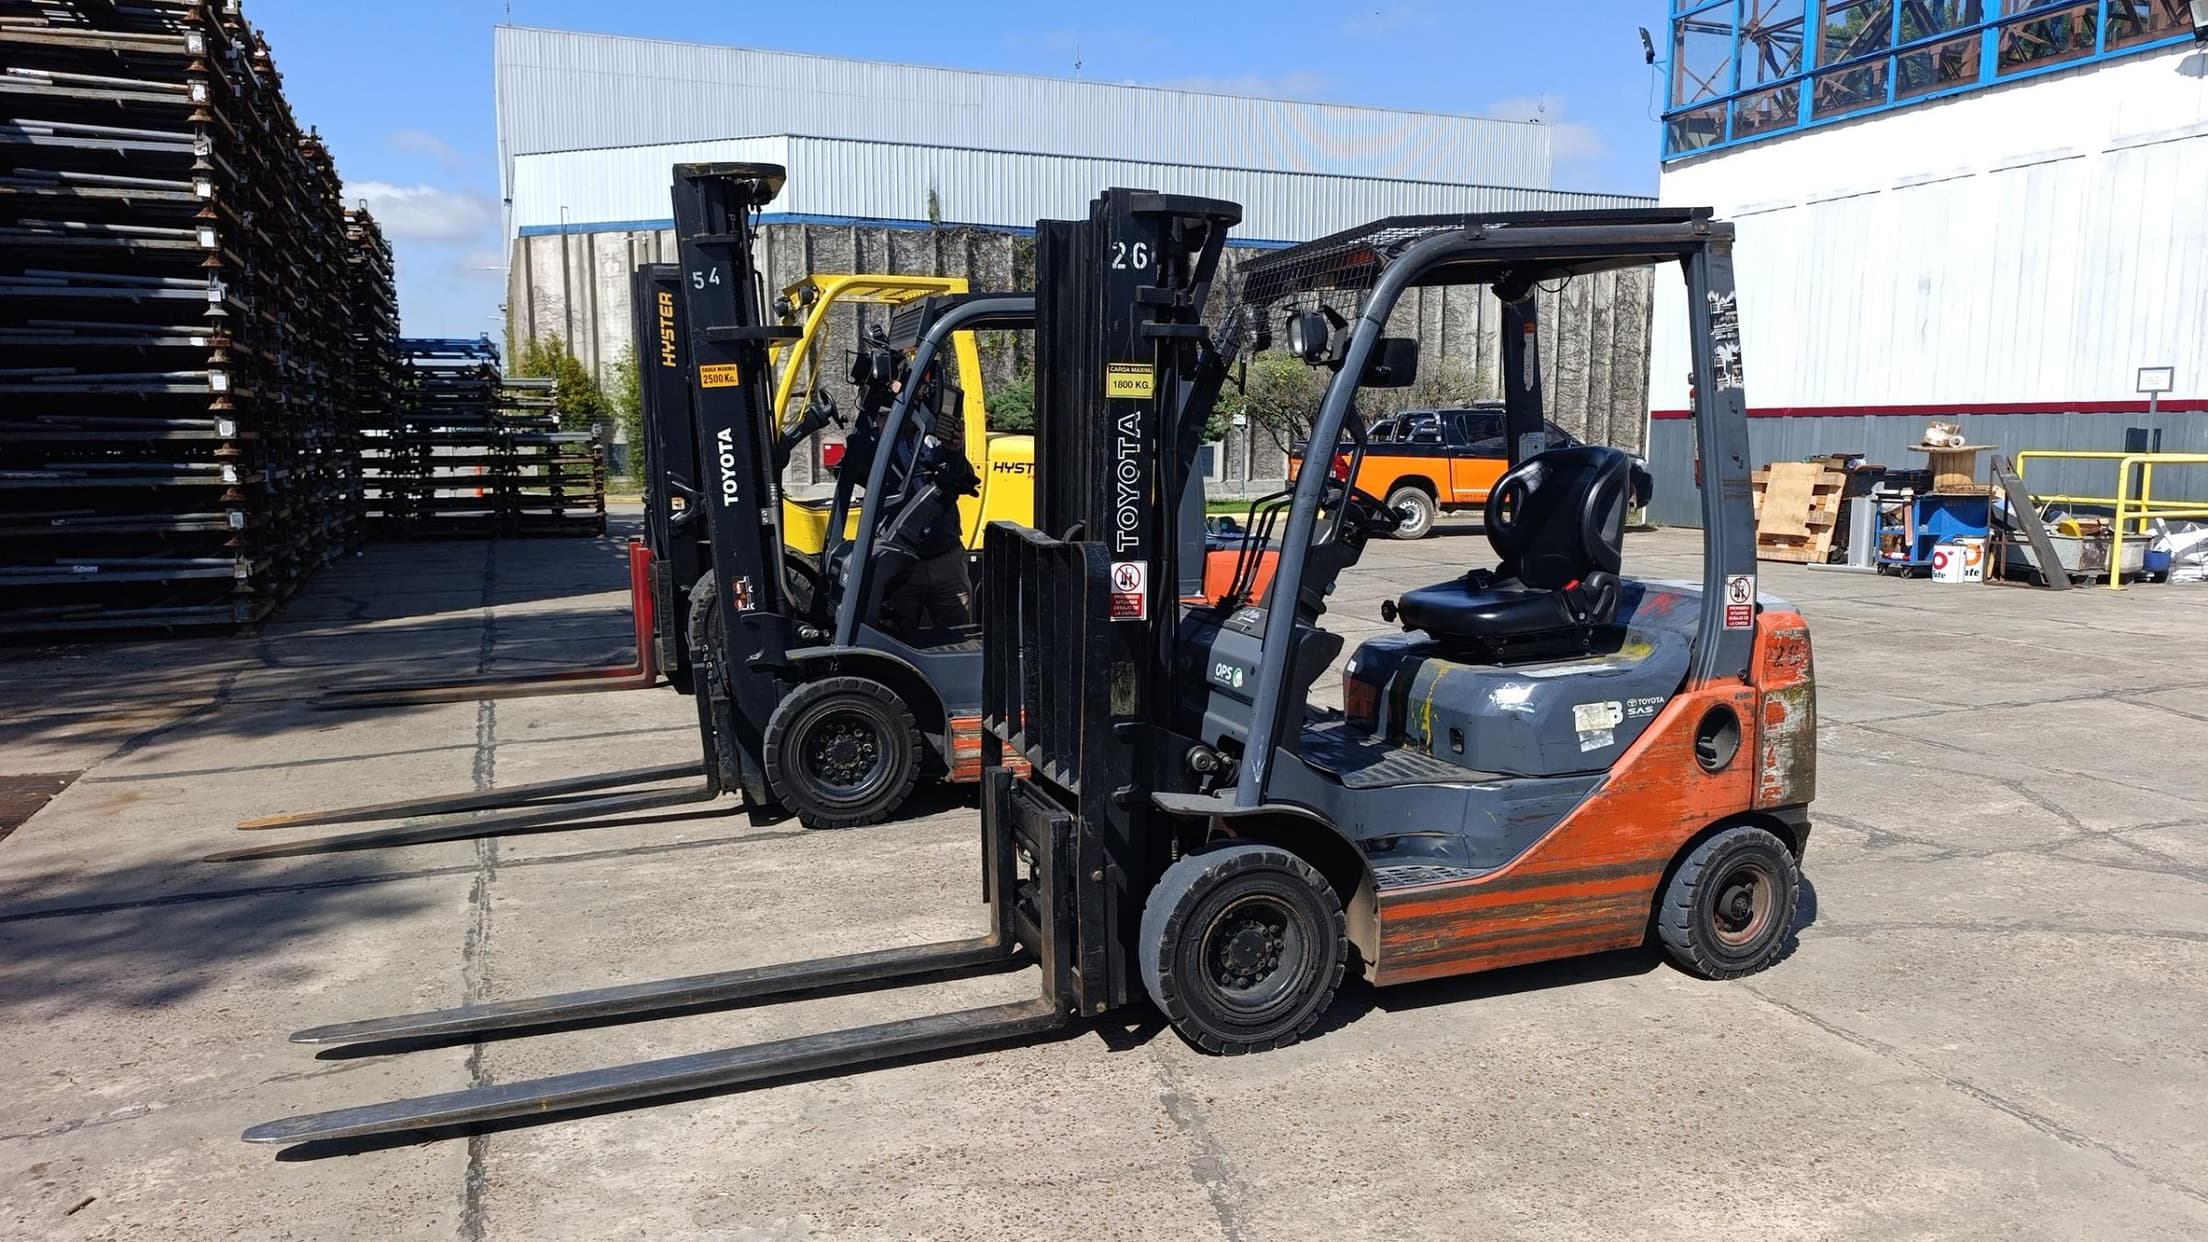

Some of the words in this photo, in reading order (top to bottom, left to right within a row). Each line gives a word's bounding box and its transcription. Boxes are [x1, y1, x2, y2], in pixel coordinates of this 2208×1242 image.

[1112, 242, 1148, 269] 26
[692, 267, 720, 289] 54
[658, 291, 677, 367] HYSTER
[703, 374, 723, 384] 2500
[1113, 380, 1134, 389] 1800
[1135, 380, 1152, 390] KG.
[717, 427, 739, 507] TOYOTA
[993, 461, 1035, 474] HYST
[1116, 410, 1141, 552] TOYOTA
[1215, 662, 1233, 681] OPS
[1627, 705, 1654, 715] SAS
[1637, 696, 1665, 705] TOYOTA
